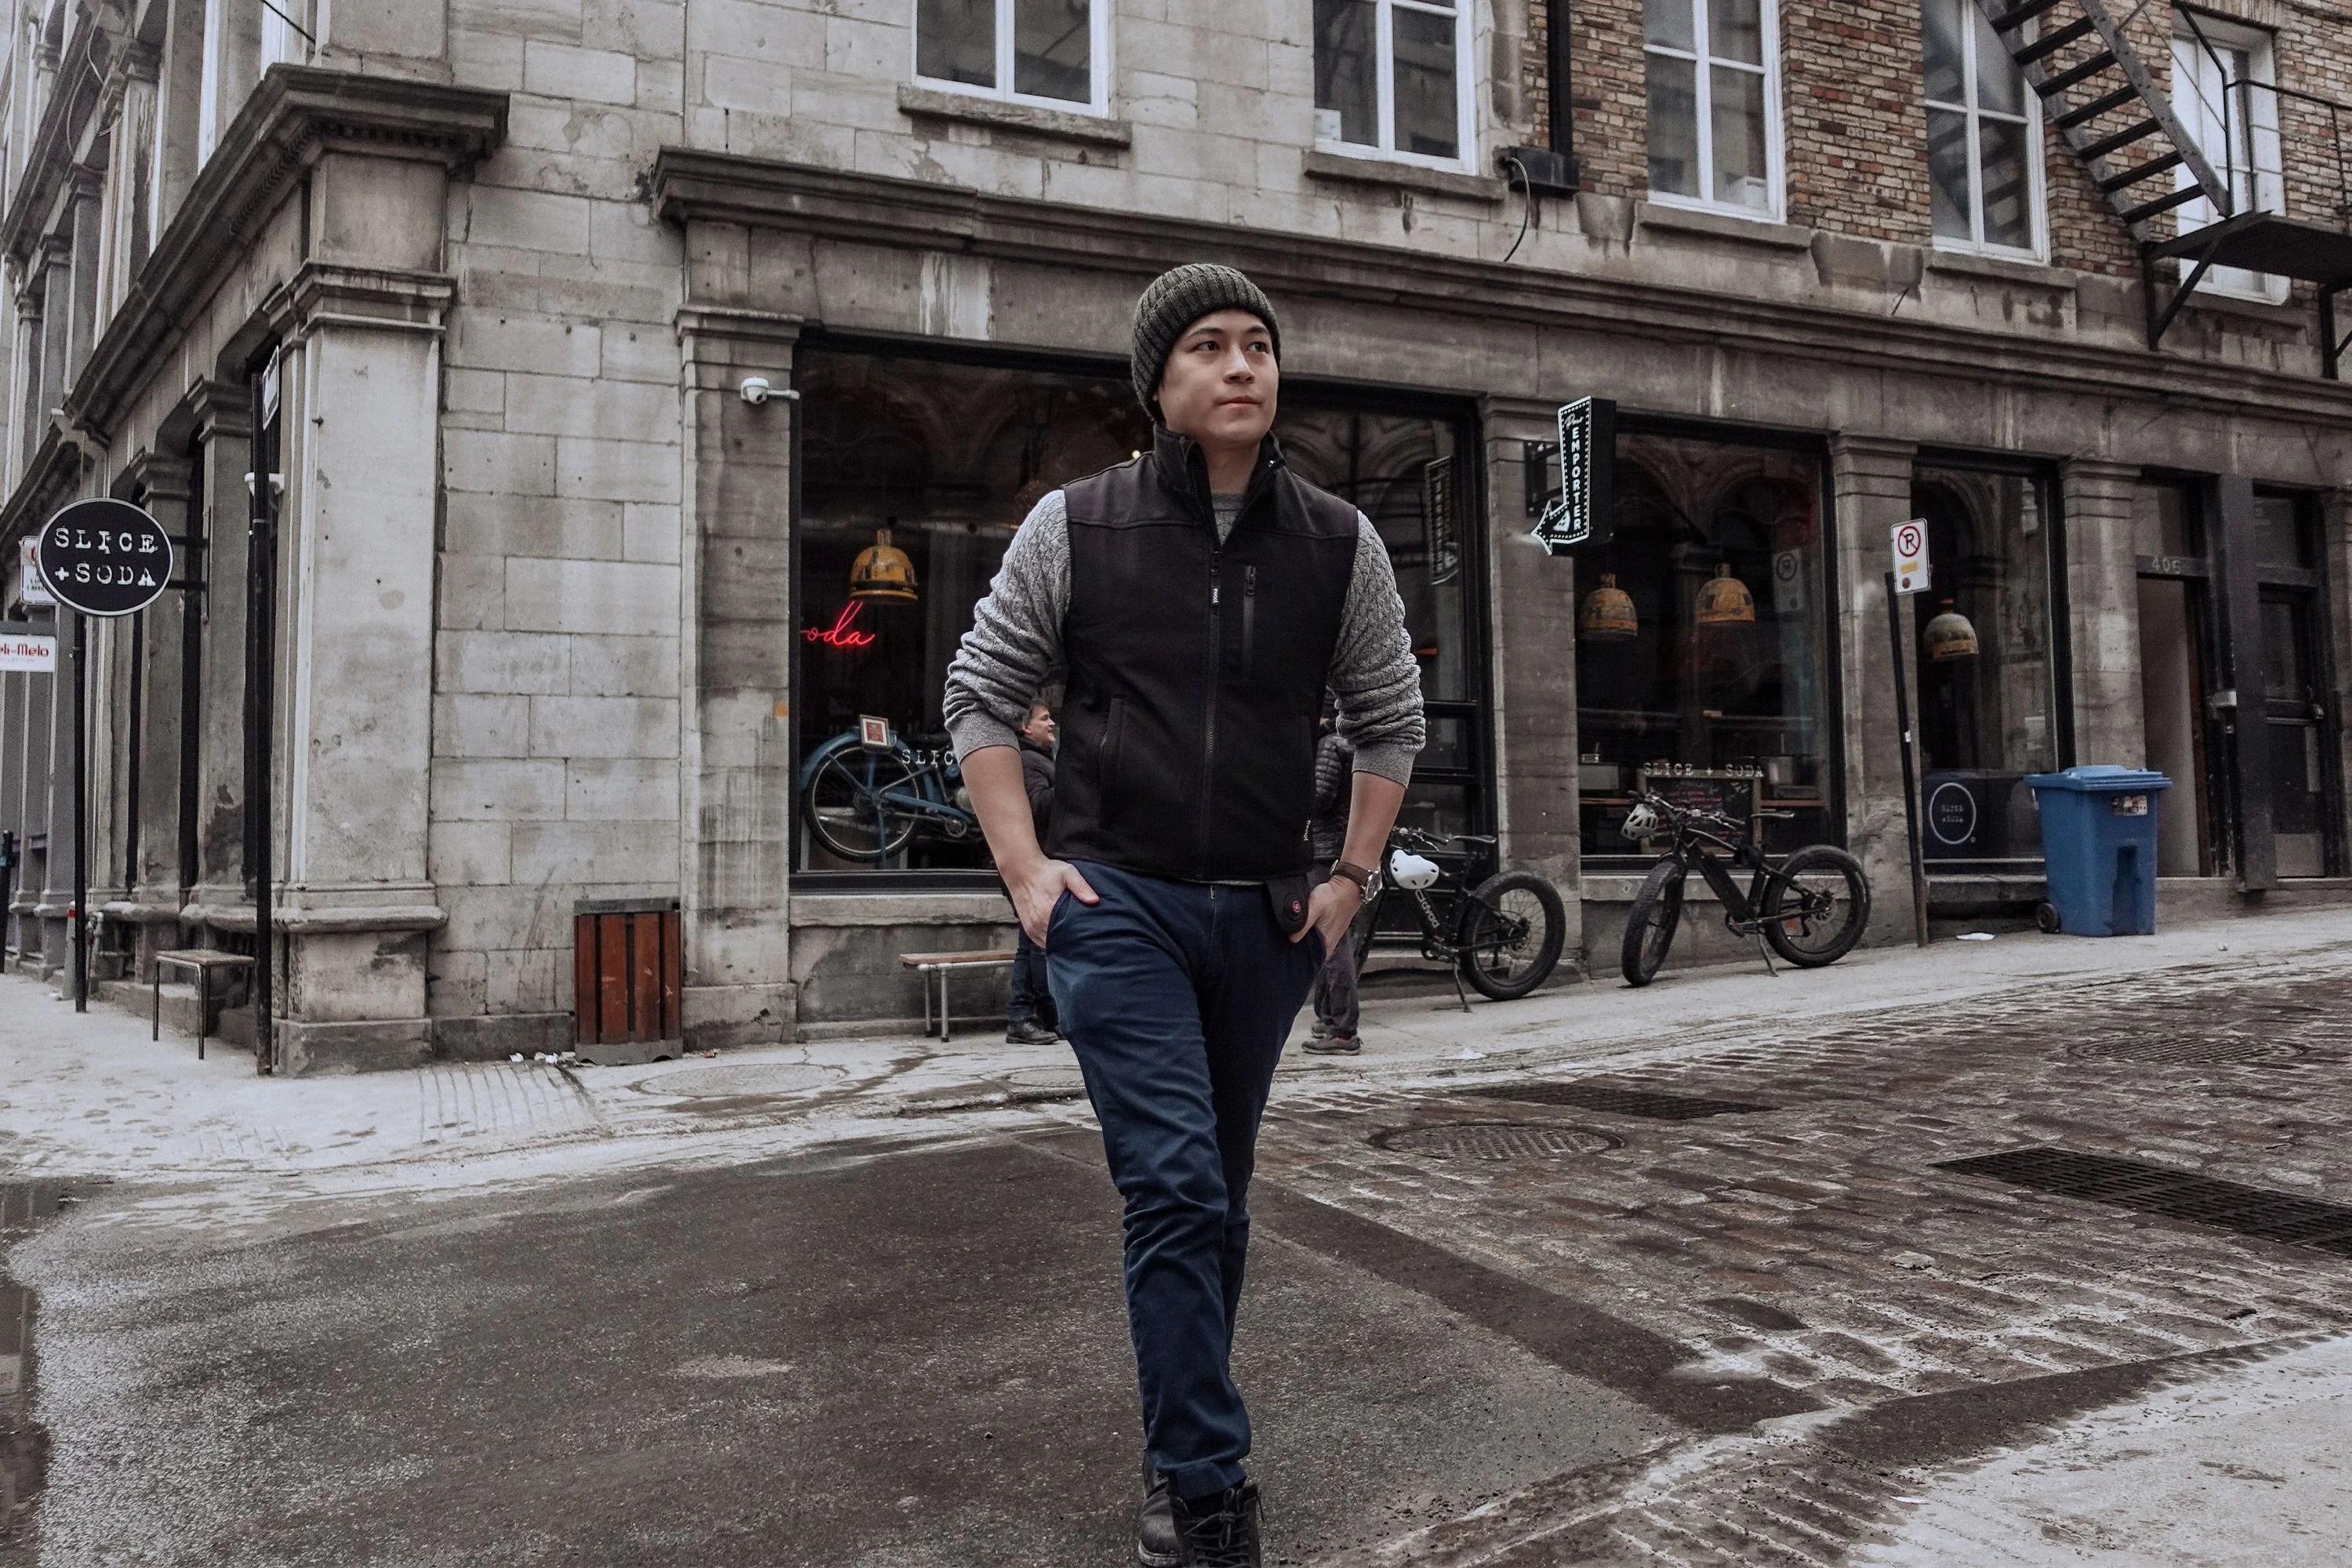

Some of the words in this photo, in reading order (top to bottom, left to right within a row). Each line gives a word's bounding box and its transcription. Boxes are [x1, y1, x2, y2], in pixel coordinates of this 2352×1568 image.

[1571, 426, 1581, 531] EMPORTER
[54, 525, 158, 554] SLICE
[800, 601, 876, 645] oda
[902, 749, 954, 768] SLIC
[1643, 762, 1693, 777] SLICE
[1726, 764, 1764, 778] SODA
